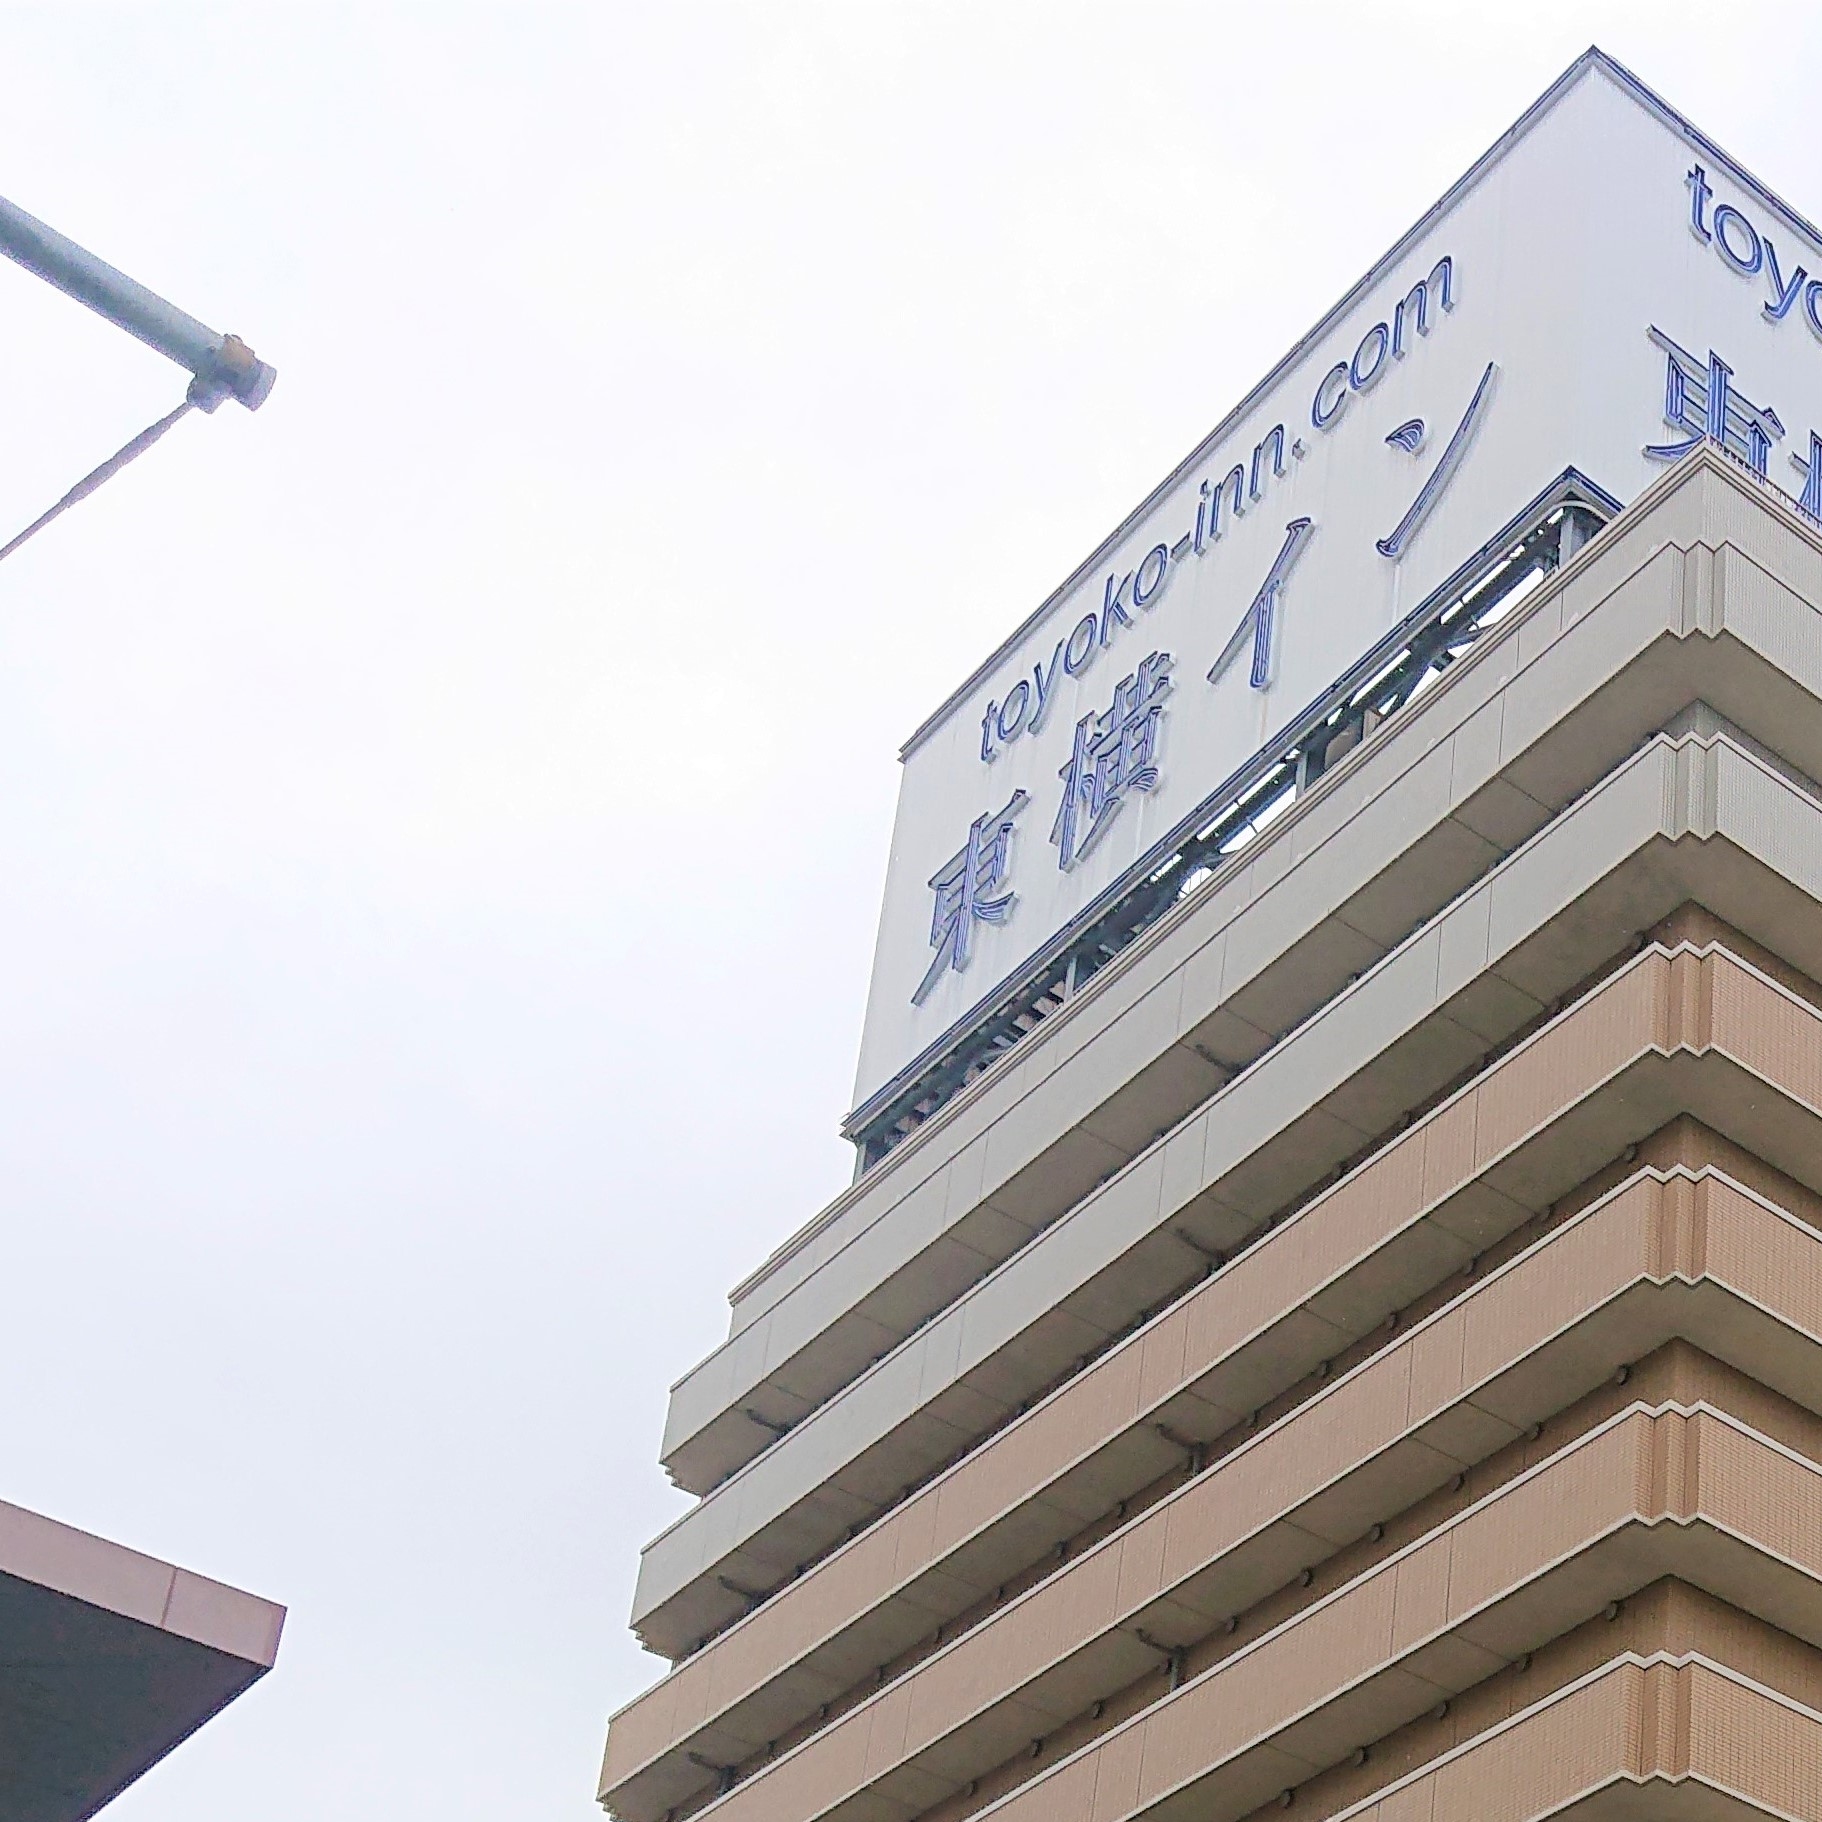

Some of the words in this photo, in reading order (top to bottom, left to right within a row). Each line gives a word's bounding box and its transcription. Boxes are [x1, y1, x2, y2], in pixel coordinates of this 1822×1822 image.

[910, 361, 1501, 1006] 東横イン
[980, 254, 1456, 764] toyoko-inn.com
